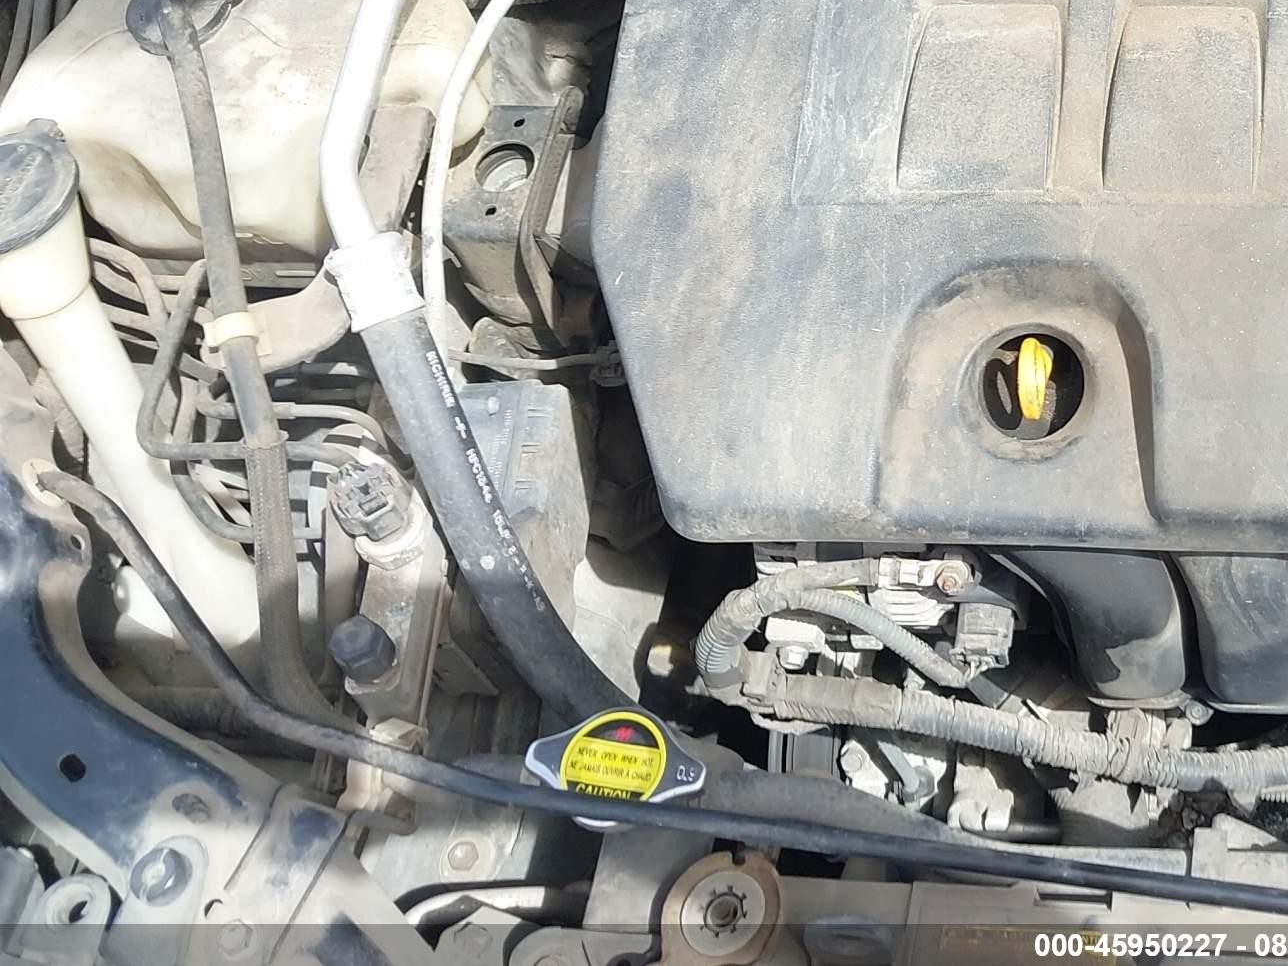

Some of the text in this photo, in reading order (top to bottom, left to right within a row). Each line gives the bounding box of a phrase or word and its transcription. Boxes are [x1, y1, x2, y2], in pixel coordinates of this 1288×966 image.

[577, 746, 598, 758] NEVER
[600, 750, 617, 761] OPEN
[621, 752, 638, 764] WHEN
